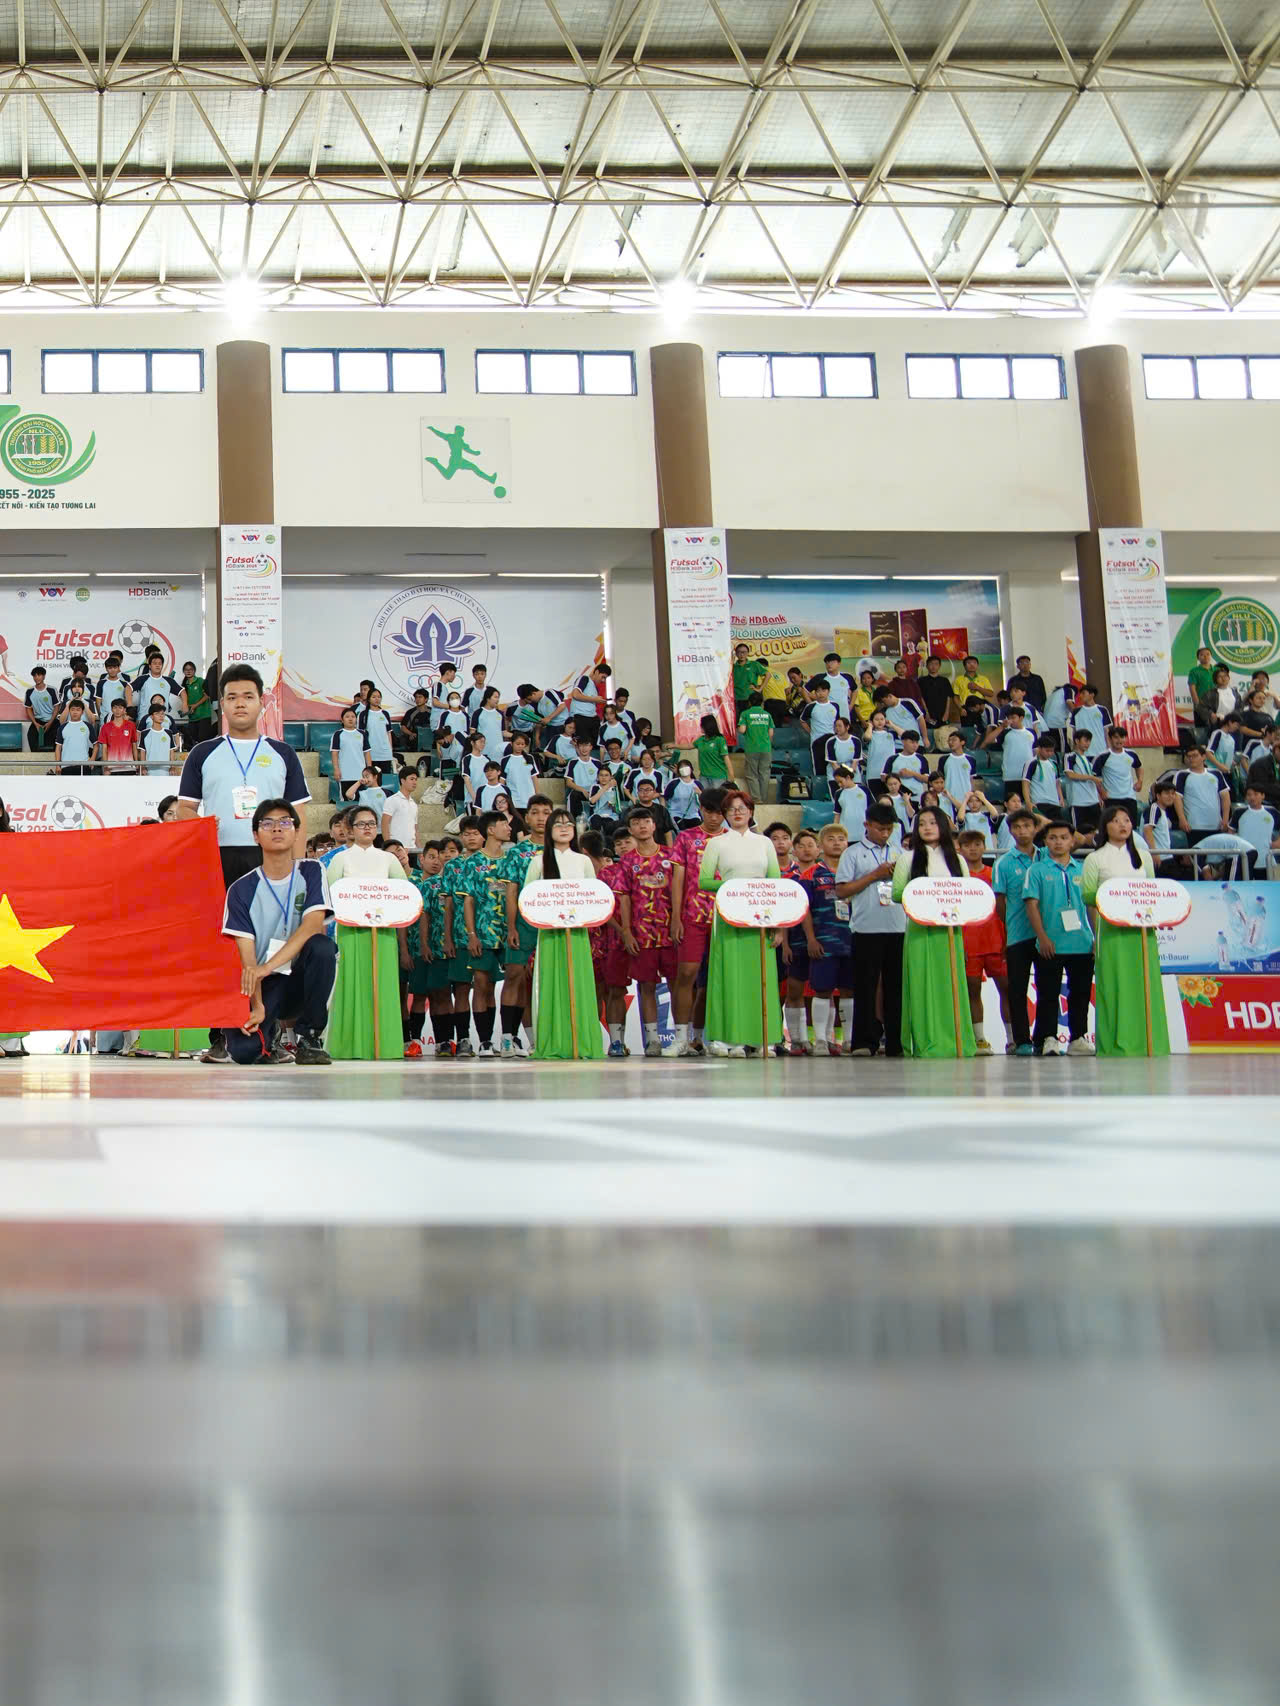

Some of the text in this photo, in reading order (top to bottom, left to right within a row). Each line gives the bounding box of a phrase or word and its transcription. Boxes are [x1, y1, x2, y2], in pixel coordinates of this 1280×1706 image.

[47, 502, 59, 511] TẠO
[39, 587, 66, 597] VOV
[128, 588, 169, 597] HDBank
[749, 614, 786, 624] HDBank
[37, 629, 114, 647] Futsal
[36, 649, 89, 660] HDBank
[228, 653, 266, 661] HDBank
[1115, 656, 1155, 664] HDBank
